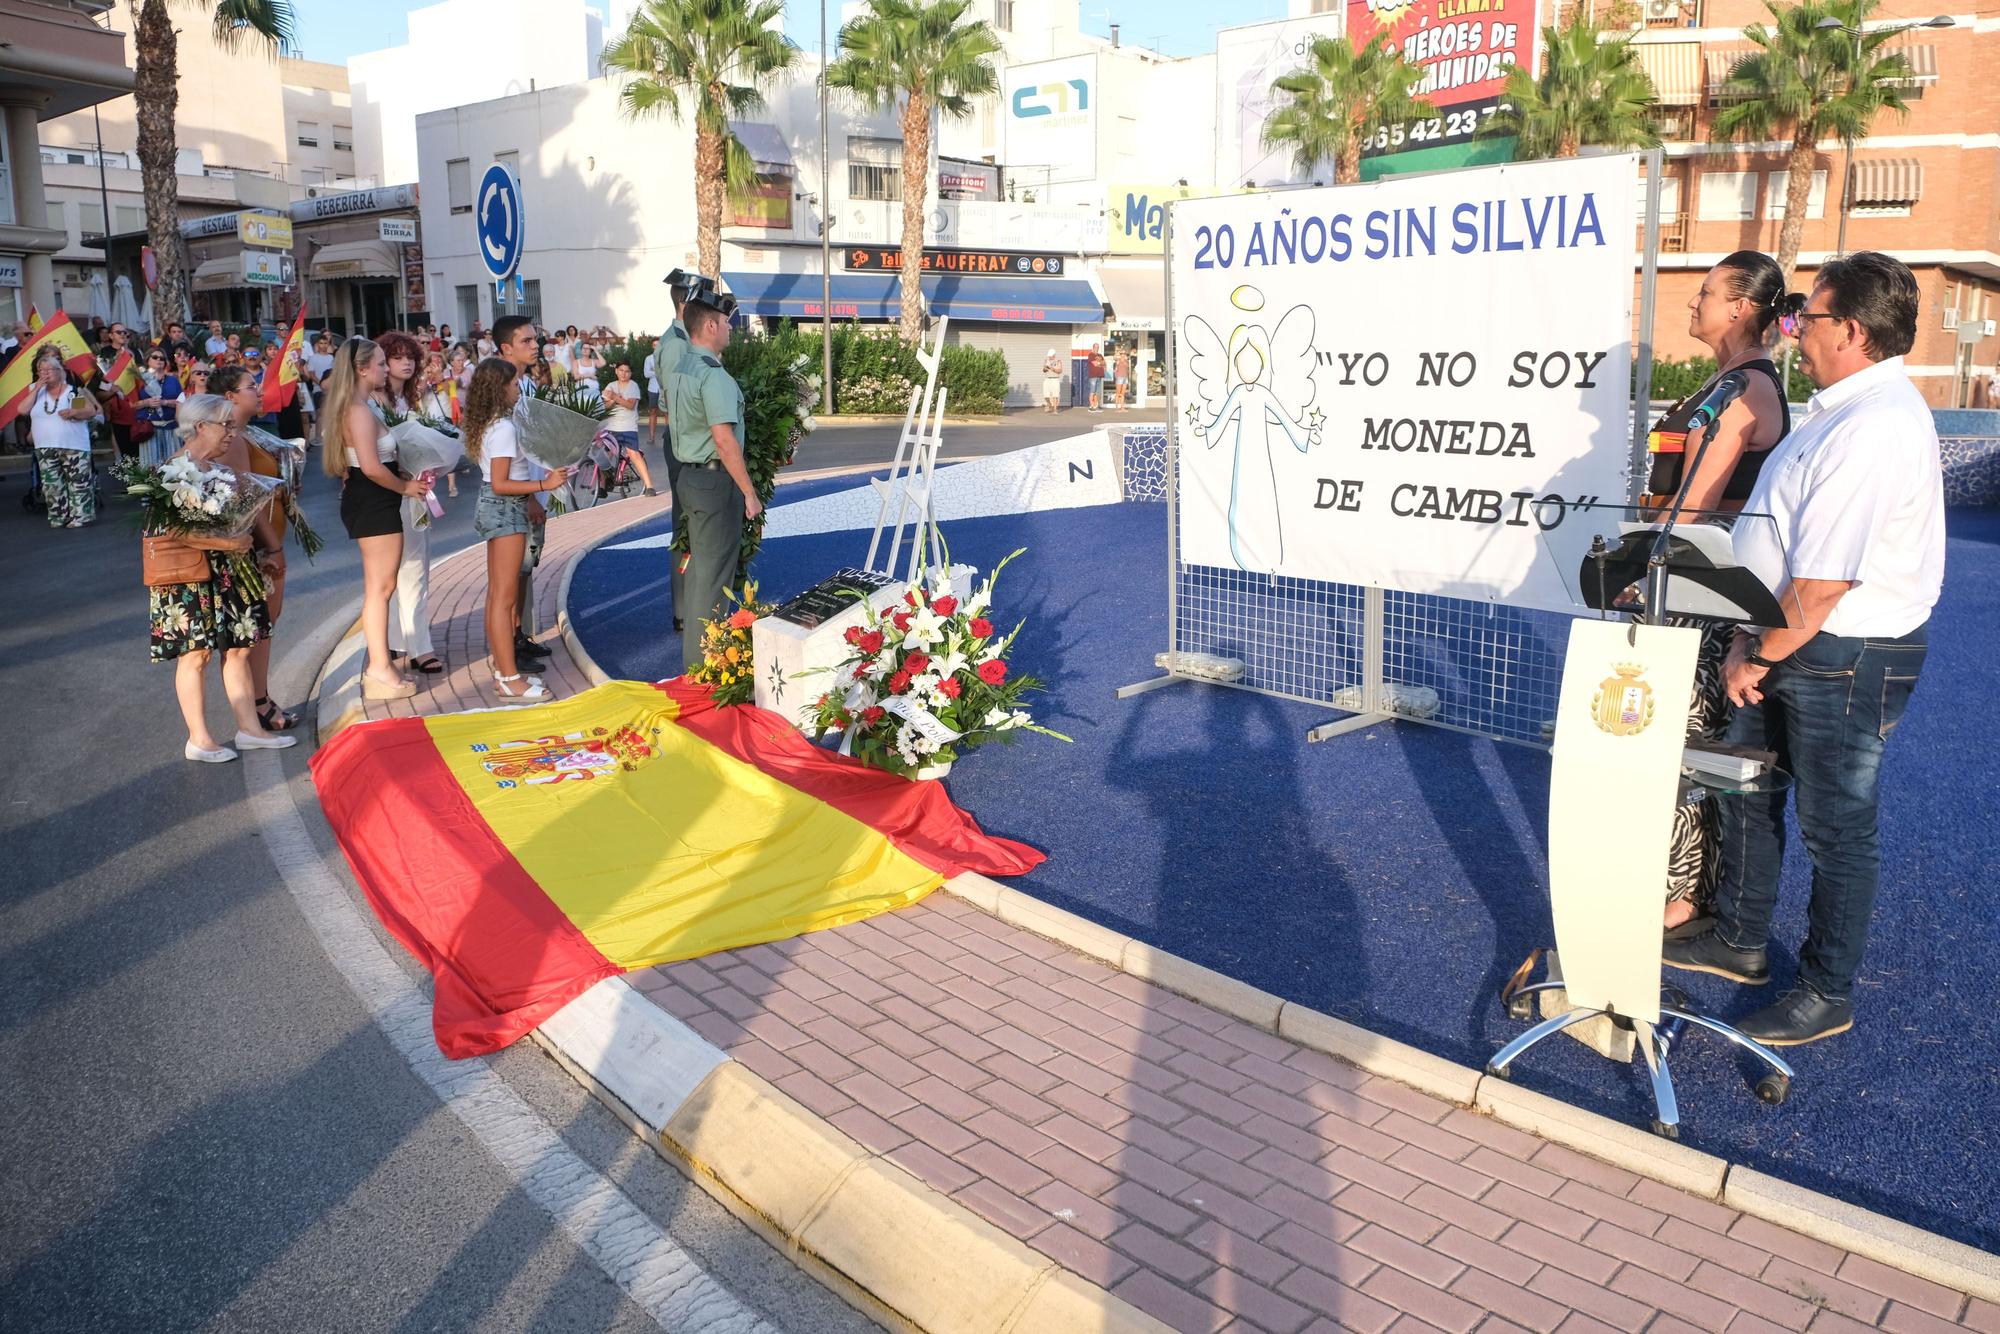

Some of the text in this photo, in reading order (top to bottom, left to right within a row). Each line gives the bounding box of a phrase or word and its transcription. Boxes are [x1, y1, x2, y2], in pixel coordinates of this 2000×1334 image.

[1437, 0, 1490, 19] LLAMA
[1404, 15, 1483, 64] HÉROES
[1489, 21, 1518, 49] DE
[1410, 118, 1442, 142] 42
[1446, 110, 1477, 137] 23
[315, 192, 376, 217] BEBEBIRRA
[383, 228, 412, 238] BIRRA
[1193, 192, 1607, 270] 20 AÑOS SIN SILVIA
[880, 252, 1009, 272] Talles AUFFRAY
[246, 271, 280, 283] MERCADONA
[1416, 351, 1477, 388] NO
[1507, 351, 1607, 390] SOY
[1360, 417, 1537, 458] MONEDA
[1068, 459, 1094, 483] N
[1313, 478, 1364, 512] DE
